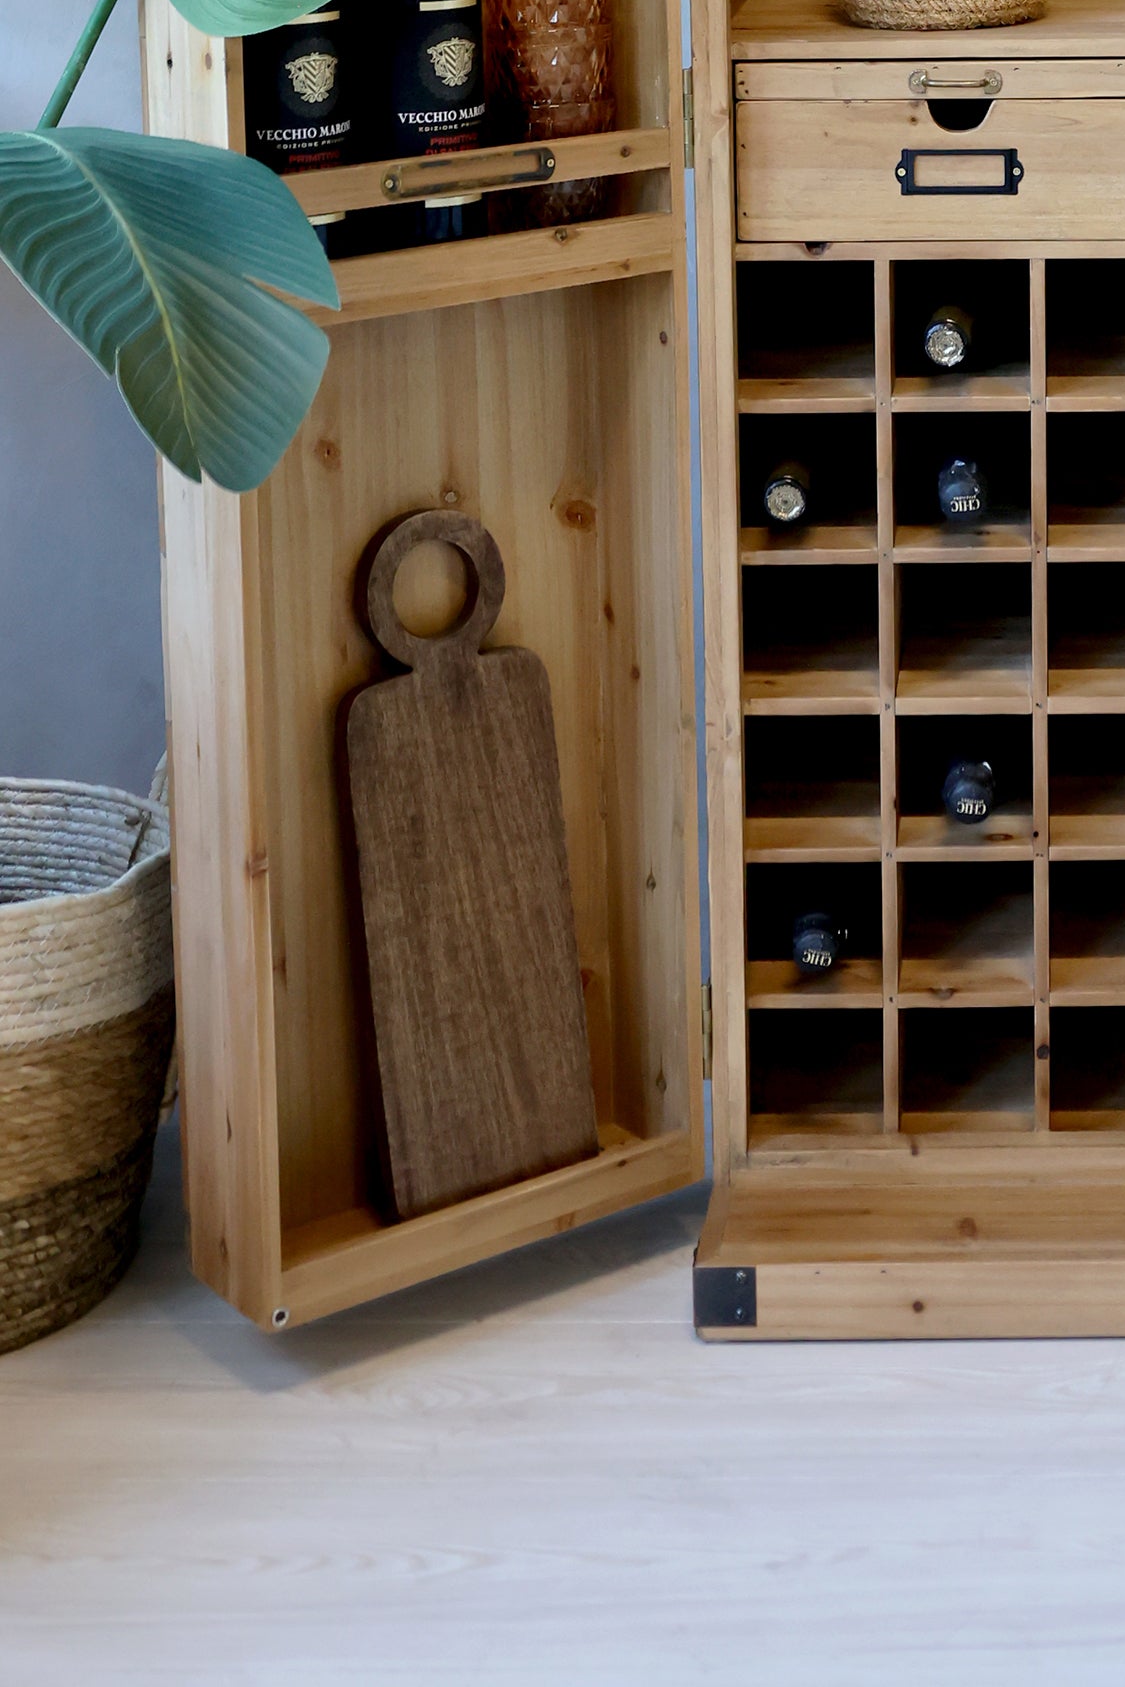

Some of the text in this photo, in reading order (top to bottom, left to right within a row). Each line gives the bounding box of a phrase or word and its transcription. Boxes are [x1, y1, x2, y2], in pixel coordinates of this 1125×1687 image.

[397, 110, 457, 124] VECCHIO
[256, 127, 317, 141] VECCHIO
[950, 498, 981, 513] CHIC
[956, 801, 987, 816] CHIC
[802, 951, 832, 967] CHIC
